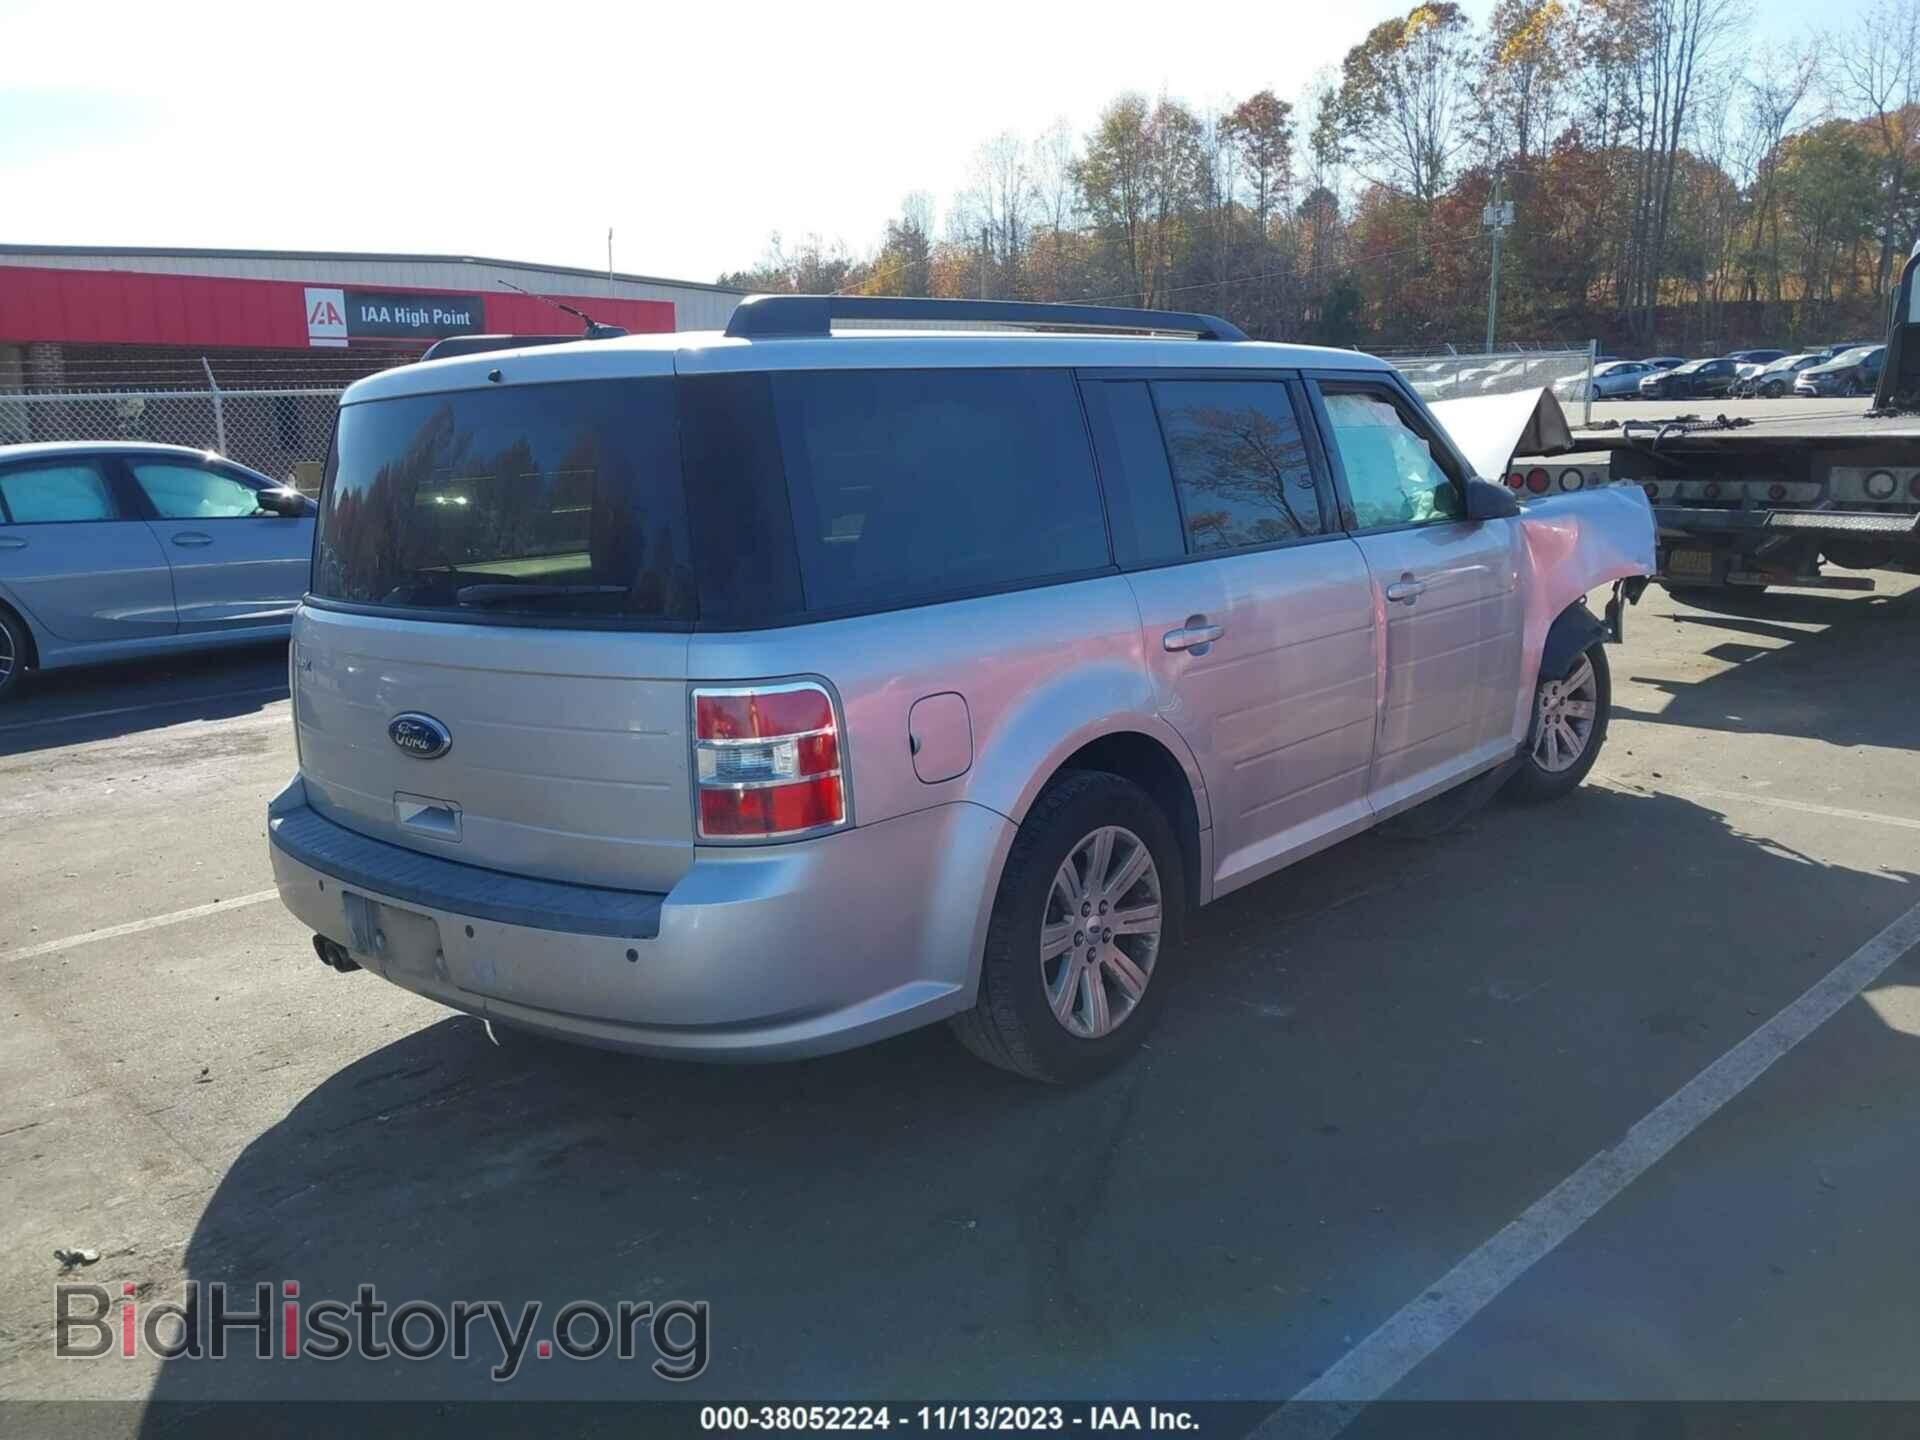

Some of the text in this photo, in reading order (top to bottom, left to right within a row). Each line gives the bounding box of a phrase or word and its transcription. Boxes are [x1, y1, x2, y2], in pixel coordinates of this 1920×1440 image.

[361, 305, 471, 328] IAA High Point
